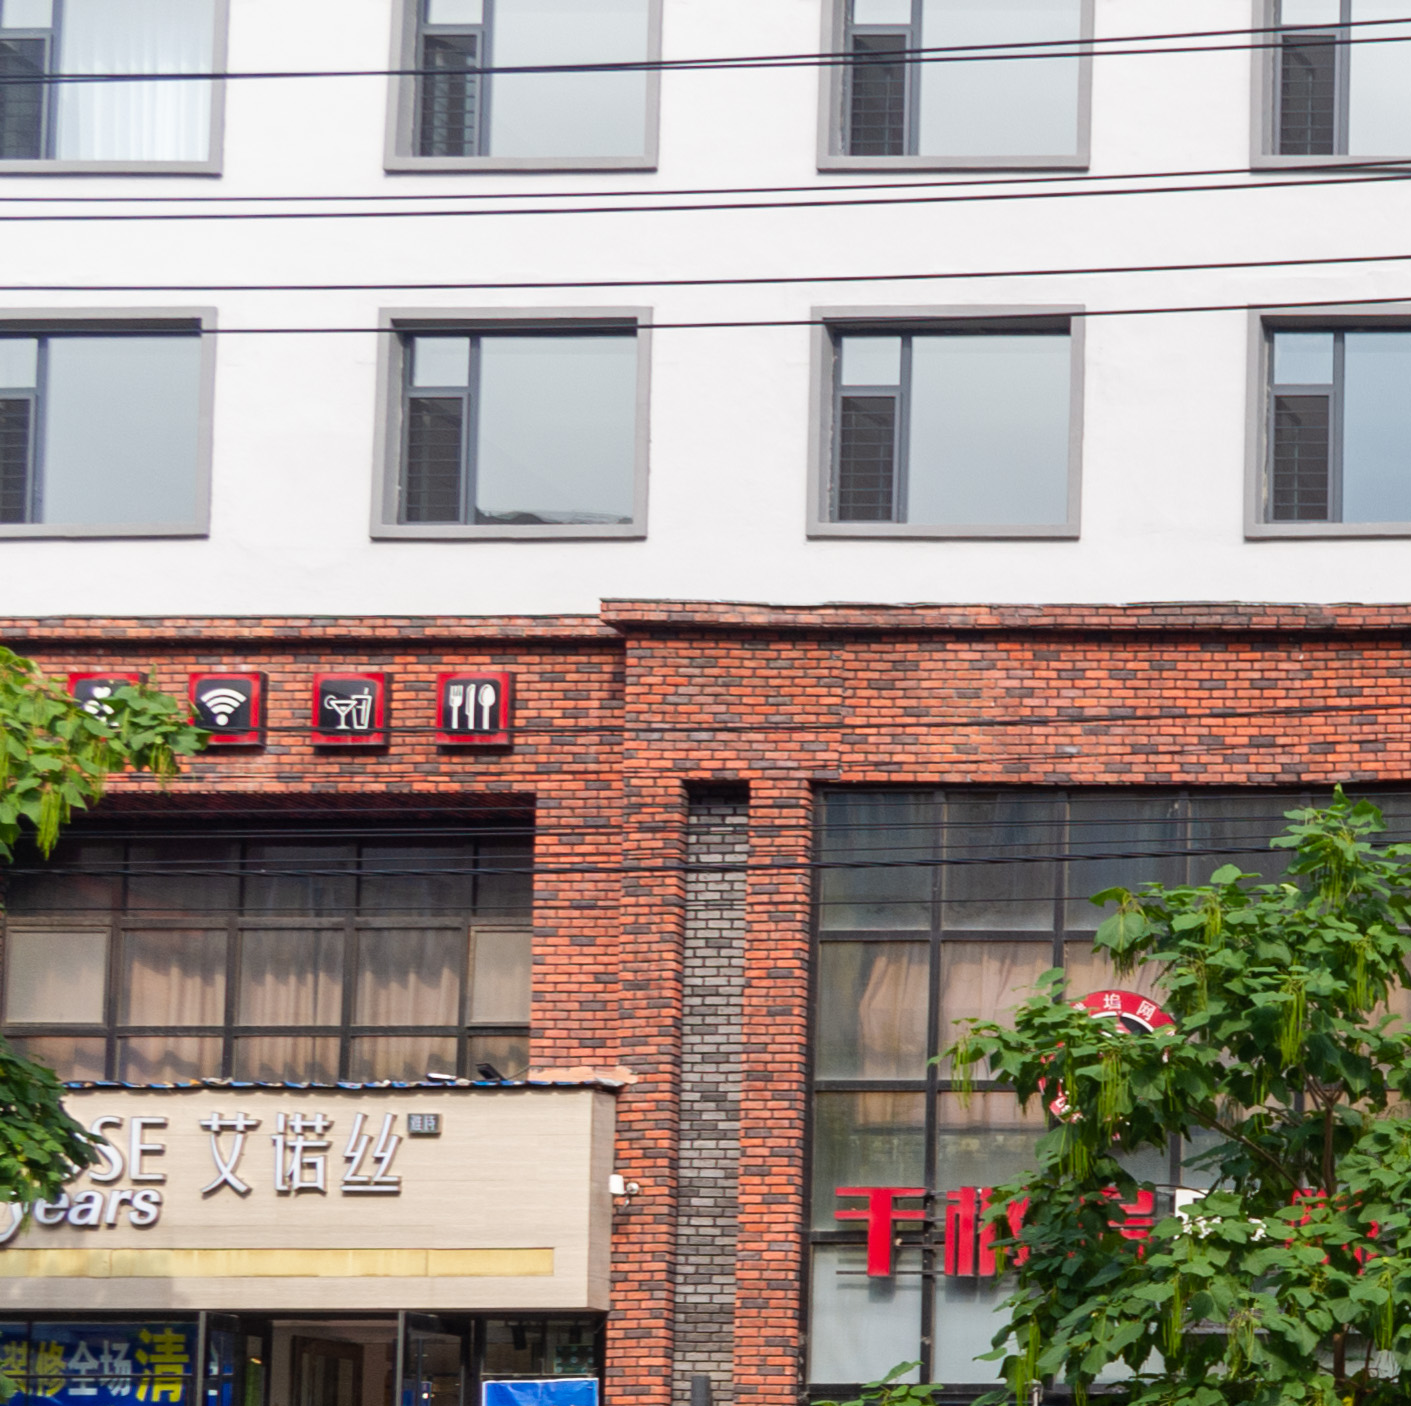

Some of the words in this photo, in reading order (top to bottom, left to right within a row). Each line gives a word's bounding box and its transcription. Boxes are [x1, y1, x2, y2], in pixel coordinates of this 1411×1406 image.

[199, 1112, 403, 1194] 艾诺丝
[2, 1328, 218, 1403] 装修全场清
